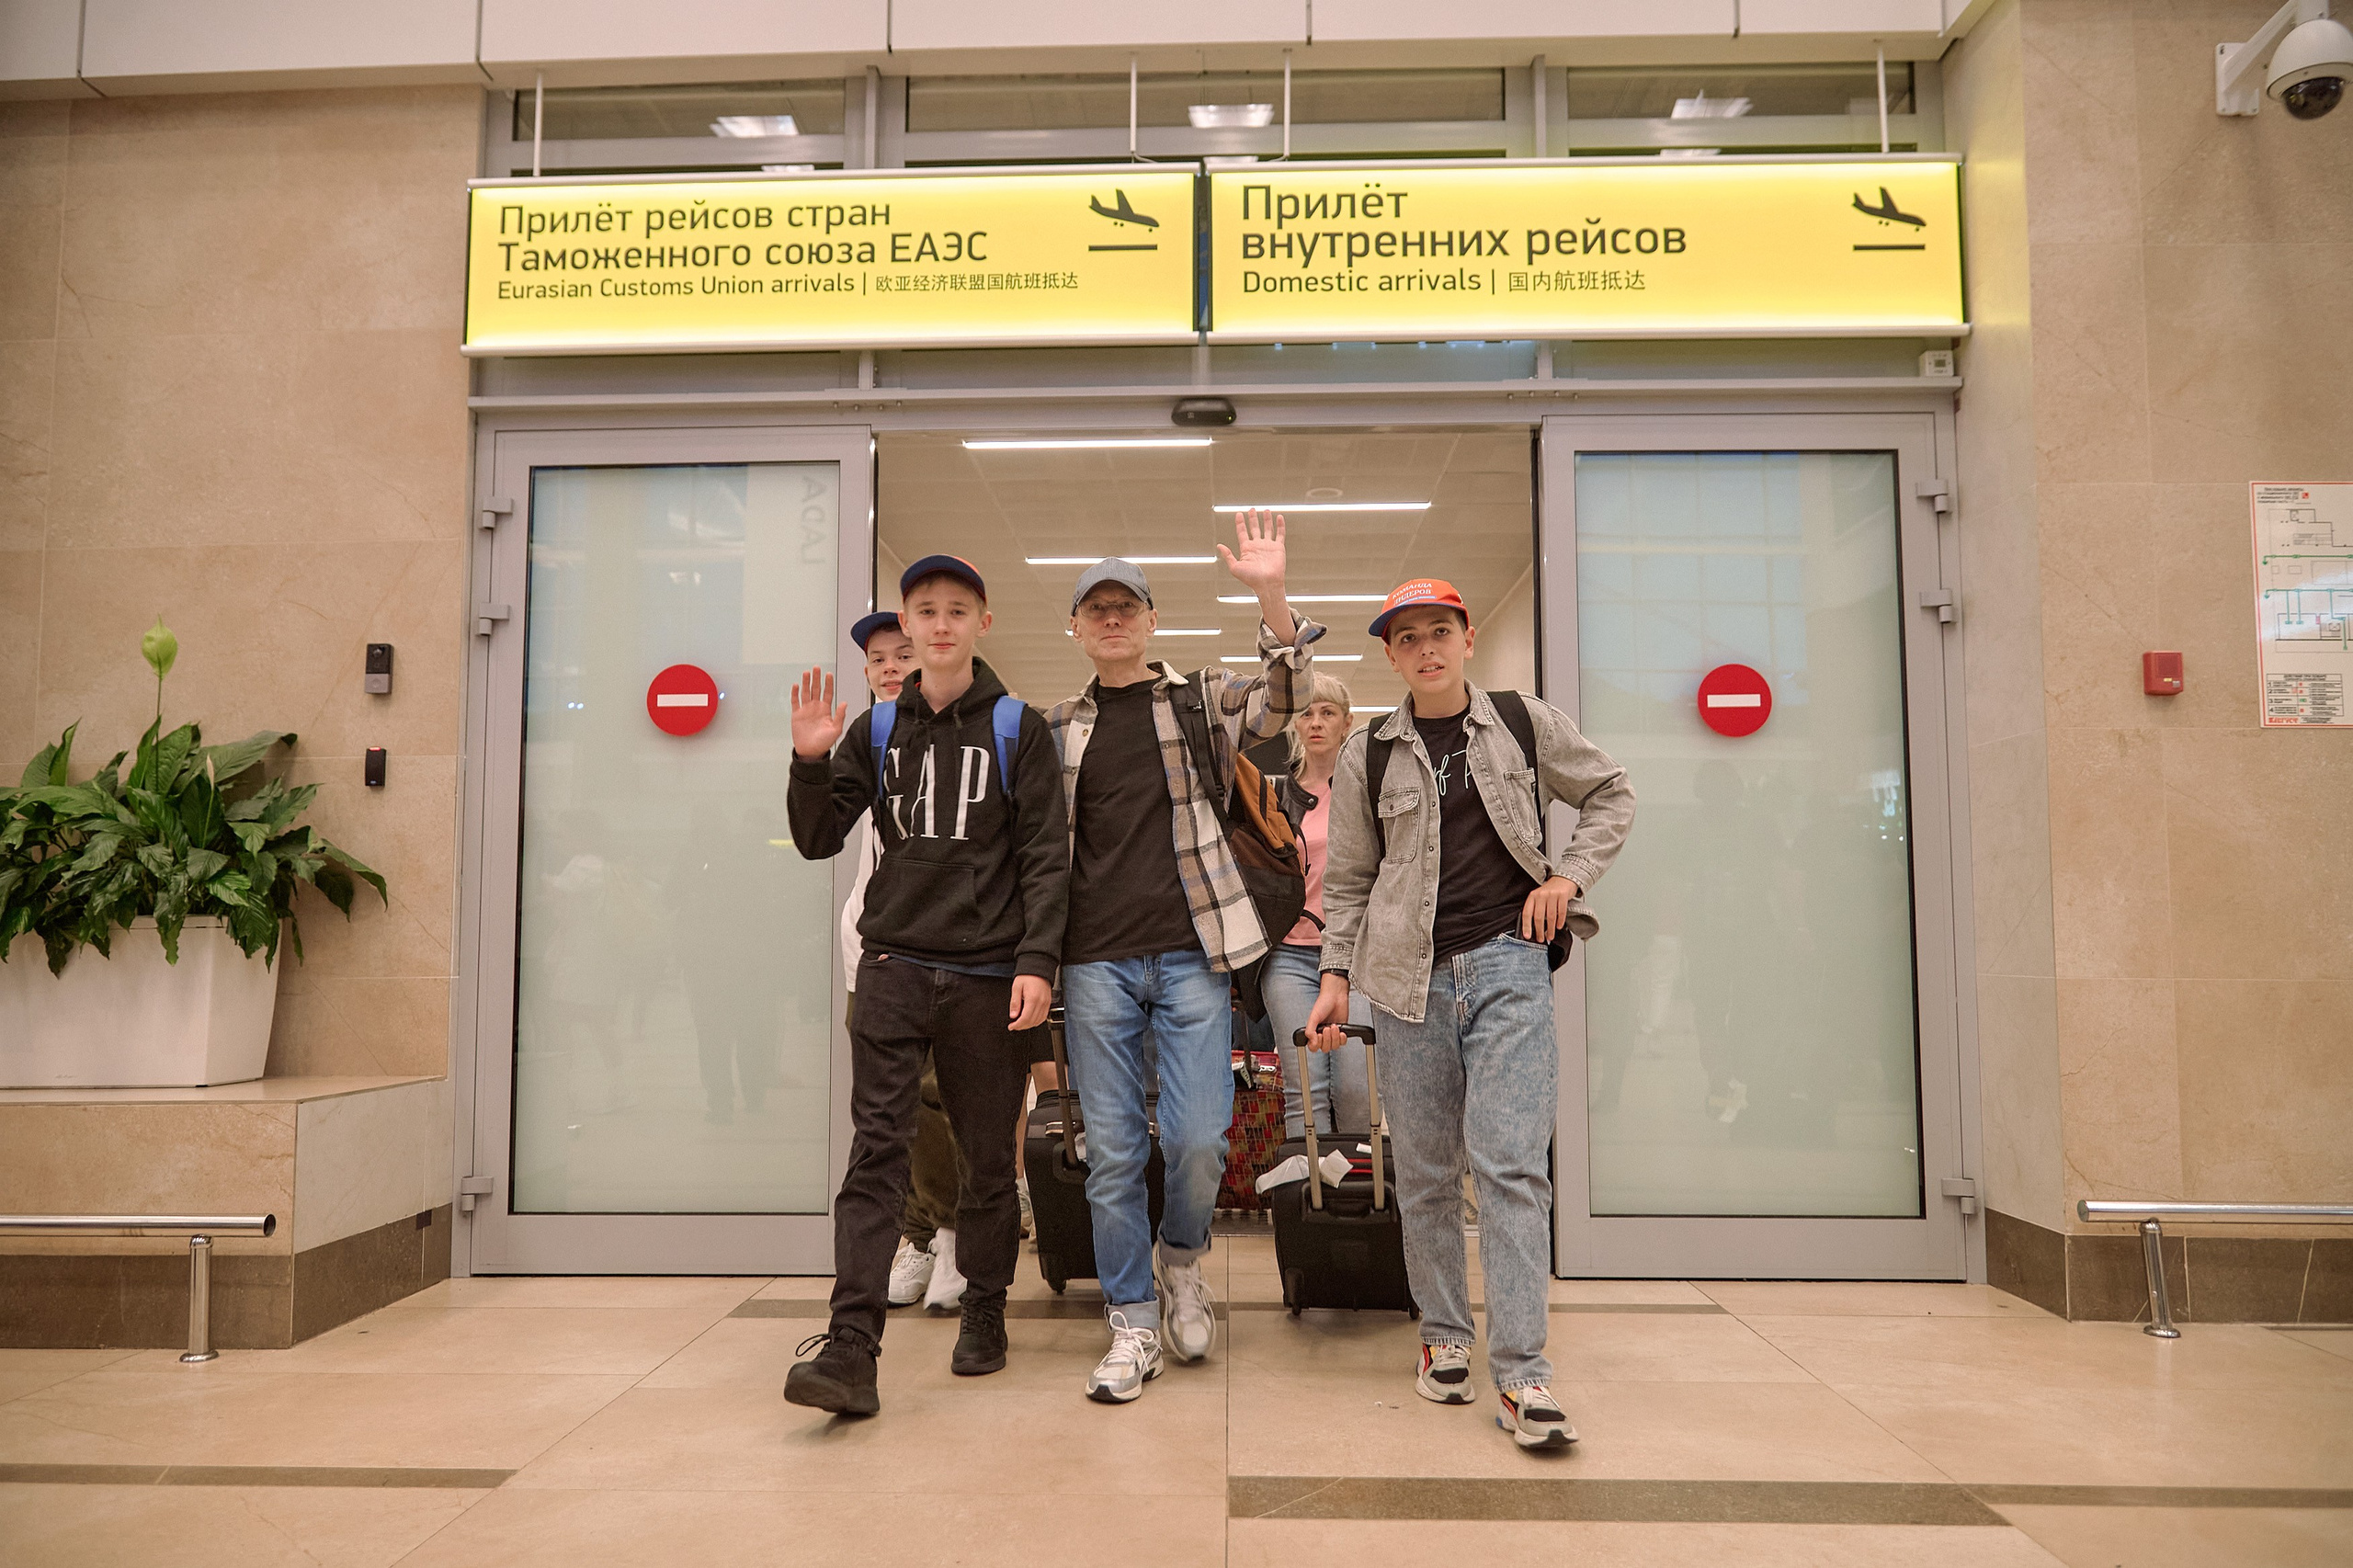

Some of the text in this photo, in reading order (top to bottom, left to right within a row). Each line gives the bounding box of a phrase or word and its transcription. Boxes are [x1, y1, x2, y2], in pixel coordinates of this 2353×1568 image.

[500, 199, 890, 243] Прилёт рейсов стран
[1242, 183, 1408, 231] Прилёт
[497, 231, 988, 272] Таможенного союза ЕАЭС
[1242, 217, 1687, 269] внутренних рейсов
[498, 272, 855, 300] Eurasian Customs Union arrivals
[875, 271, 1079, 292] 欧亚经济联盟国航班抵达
[1243, 267, 1482, 293] Domestic arrivals
[1508, 269, 1646, 292] 国内航班抵达
[883, 744, 991, 841] GAP
